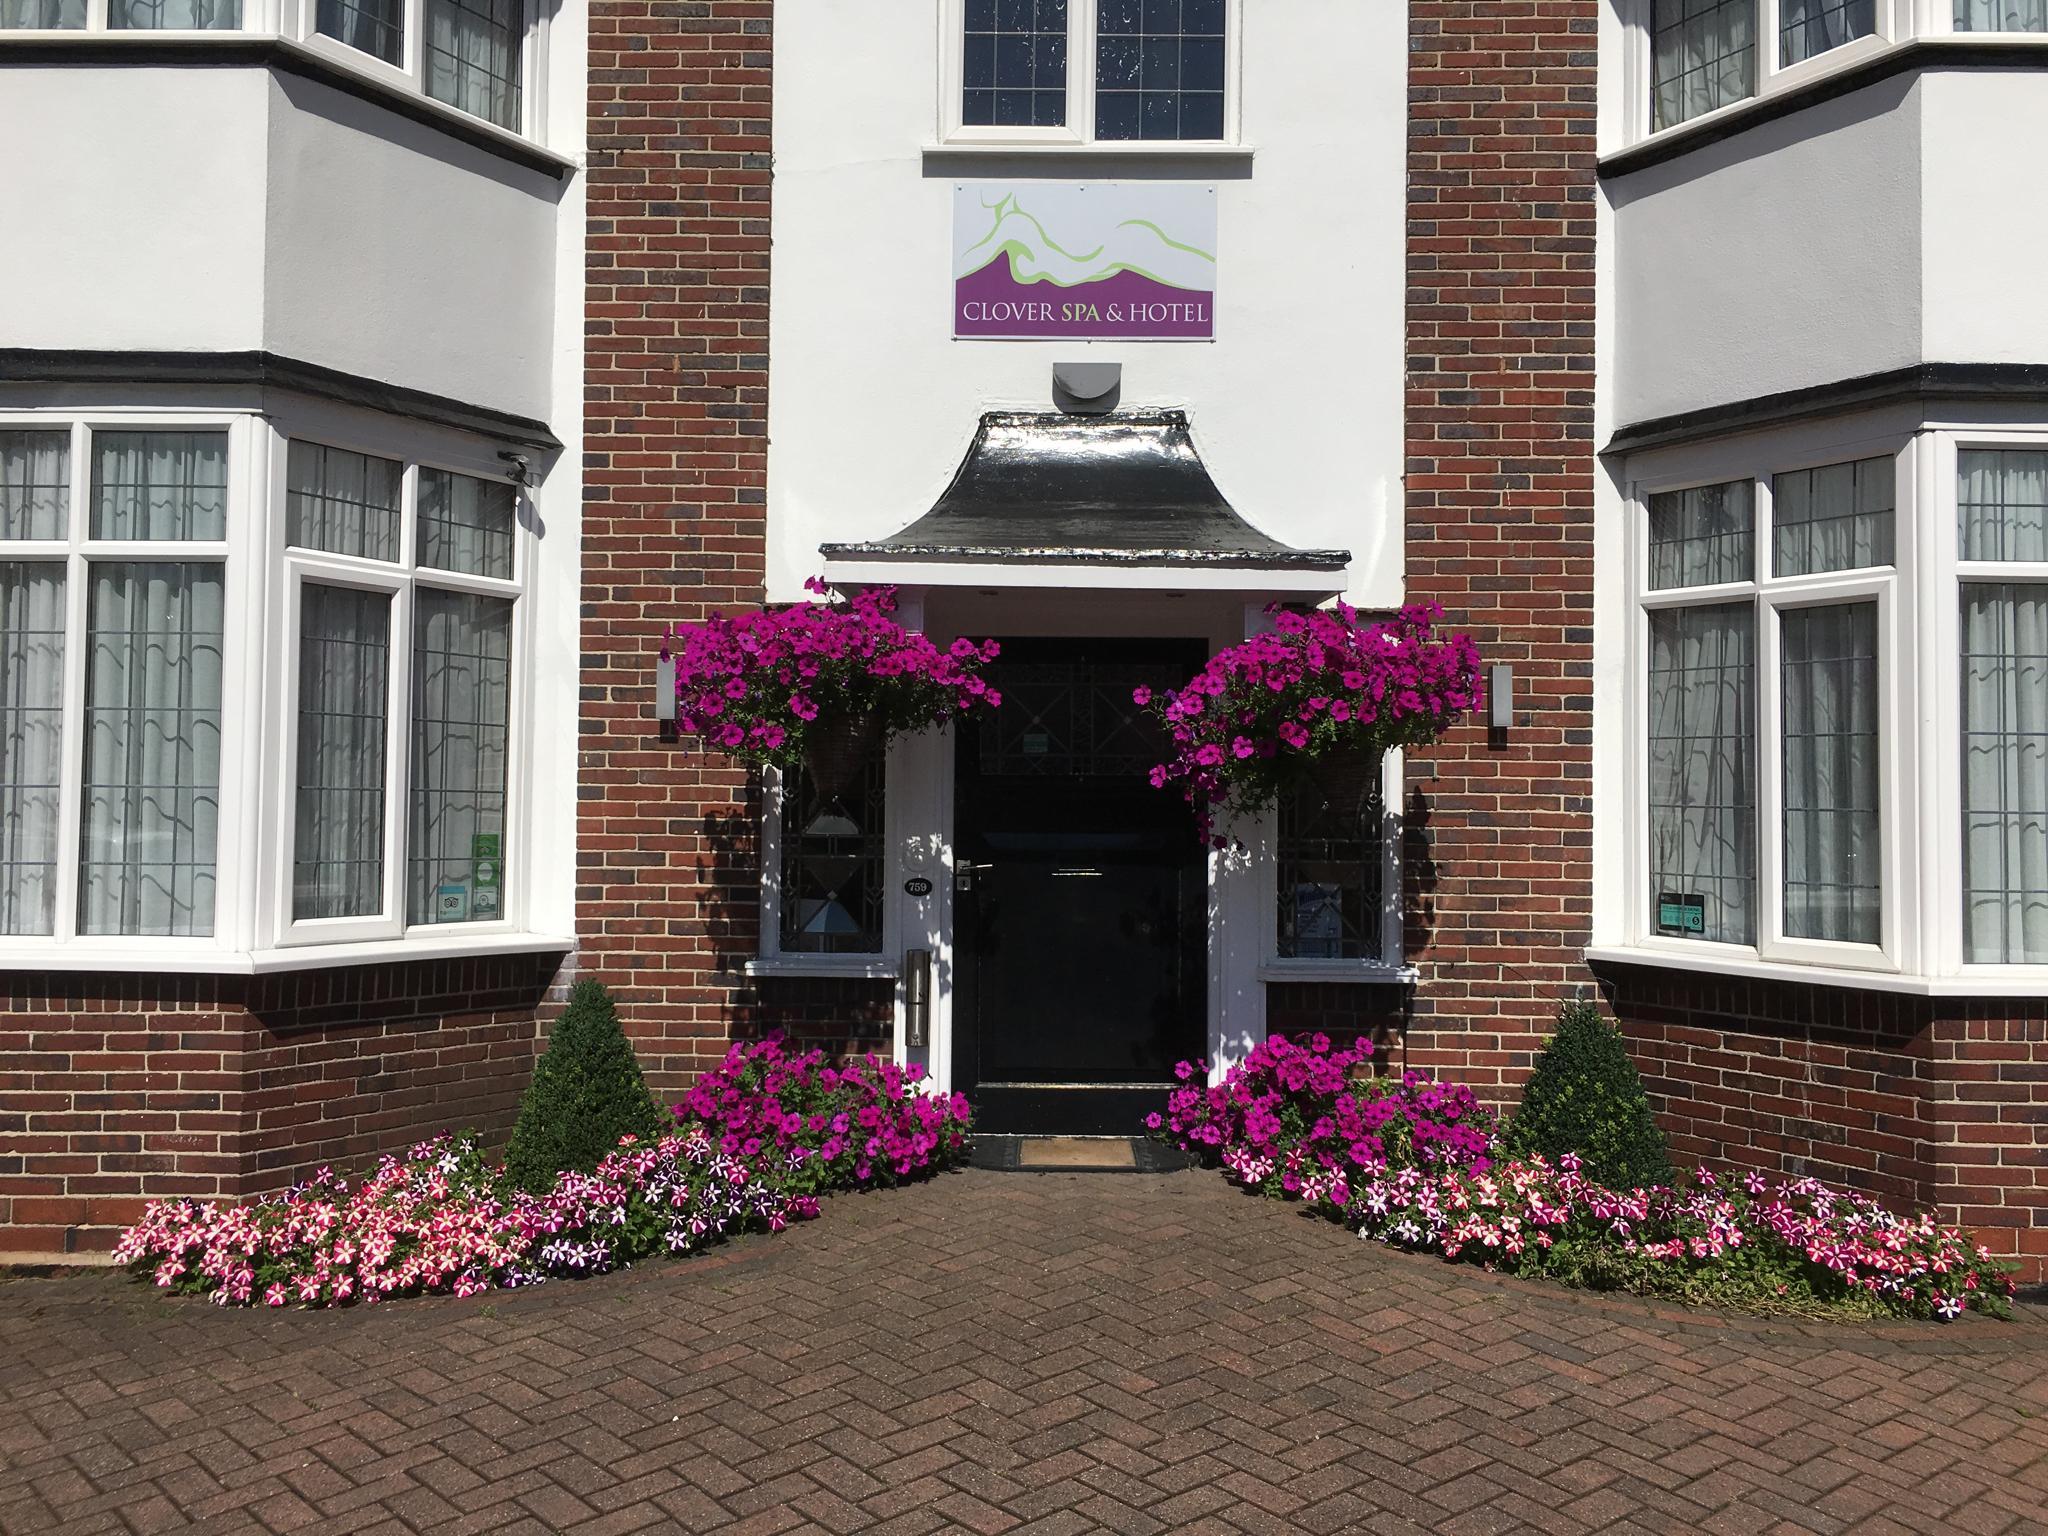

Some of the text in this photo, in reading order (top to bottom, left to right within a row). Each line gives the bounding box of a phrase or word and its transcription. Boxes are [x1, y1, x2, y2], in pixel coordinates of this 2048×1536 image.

[963, 302, 1209, 322] CLOVER SPA & HOTEL
[908, 883, 927, 892] 759
